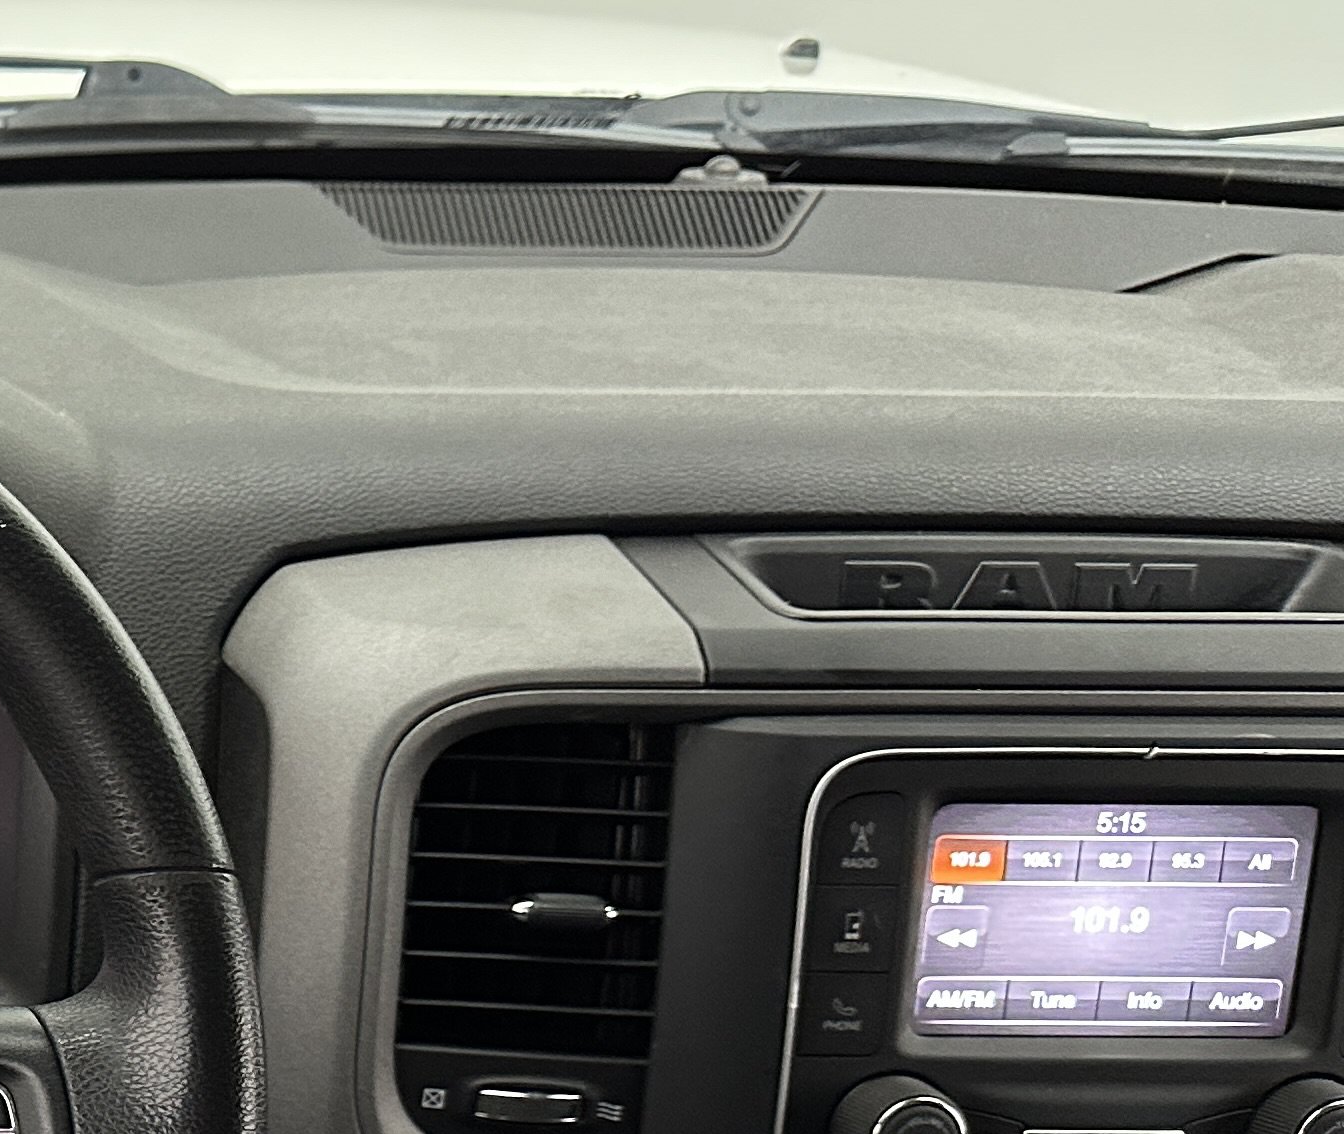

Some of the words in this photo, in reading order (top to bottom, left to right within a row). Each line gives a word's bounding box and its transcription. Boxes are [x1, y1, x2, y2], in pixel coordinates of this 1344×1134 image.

[839, 560, 1199, 611] RAM
[1096, 811, 1147, 834] 5:15
[930, 885, 964, 904] FM
[1070, 905, 1151, 934] 101.9
[925, 990, 997, 1010] AM/FM
[1030, 990, 1077, 1010] Tune
[1126, 990, 1163, 1010] Info
[1208, 991, 1264, 1011] Audio
